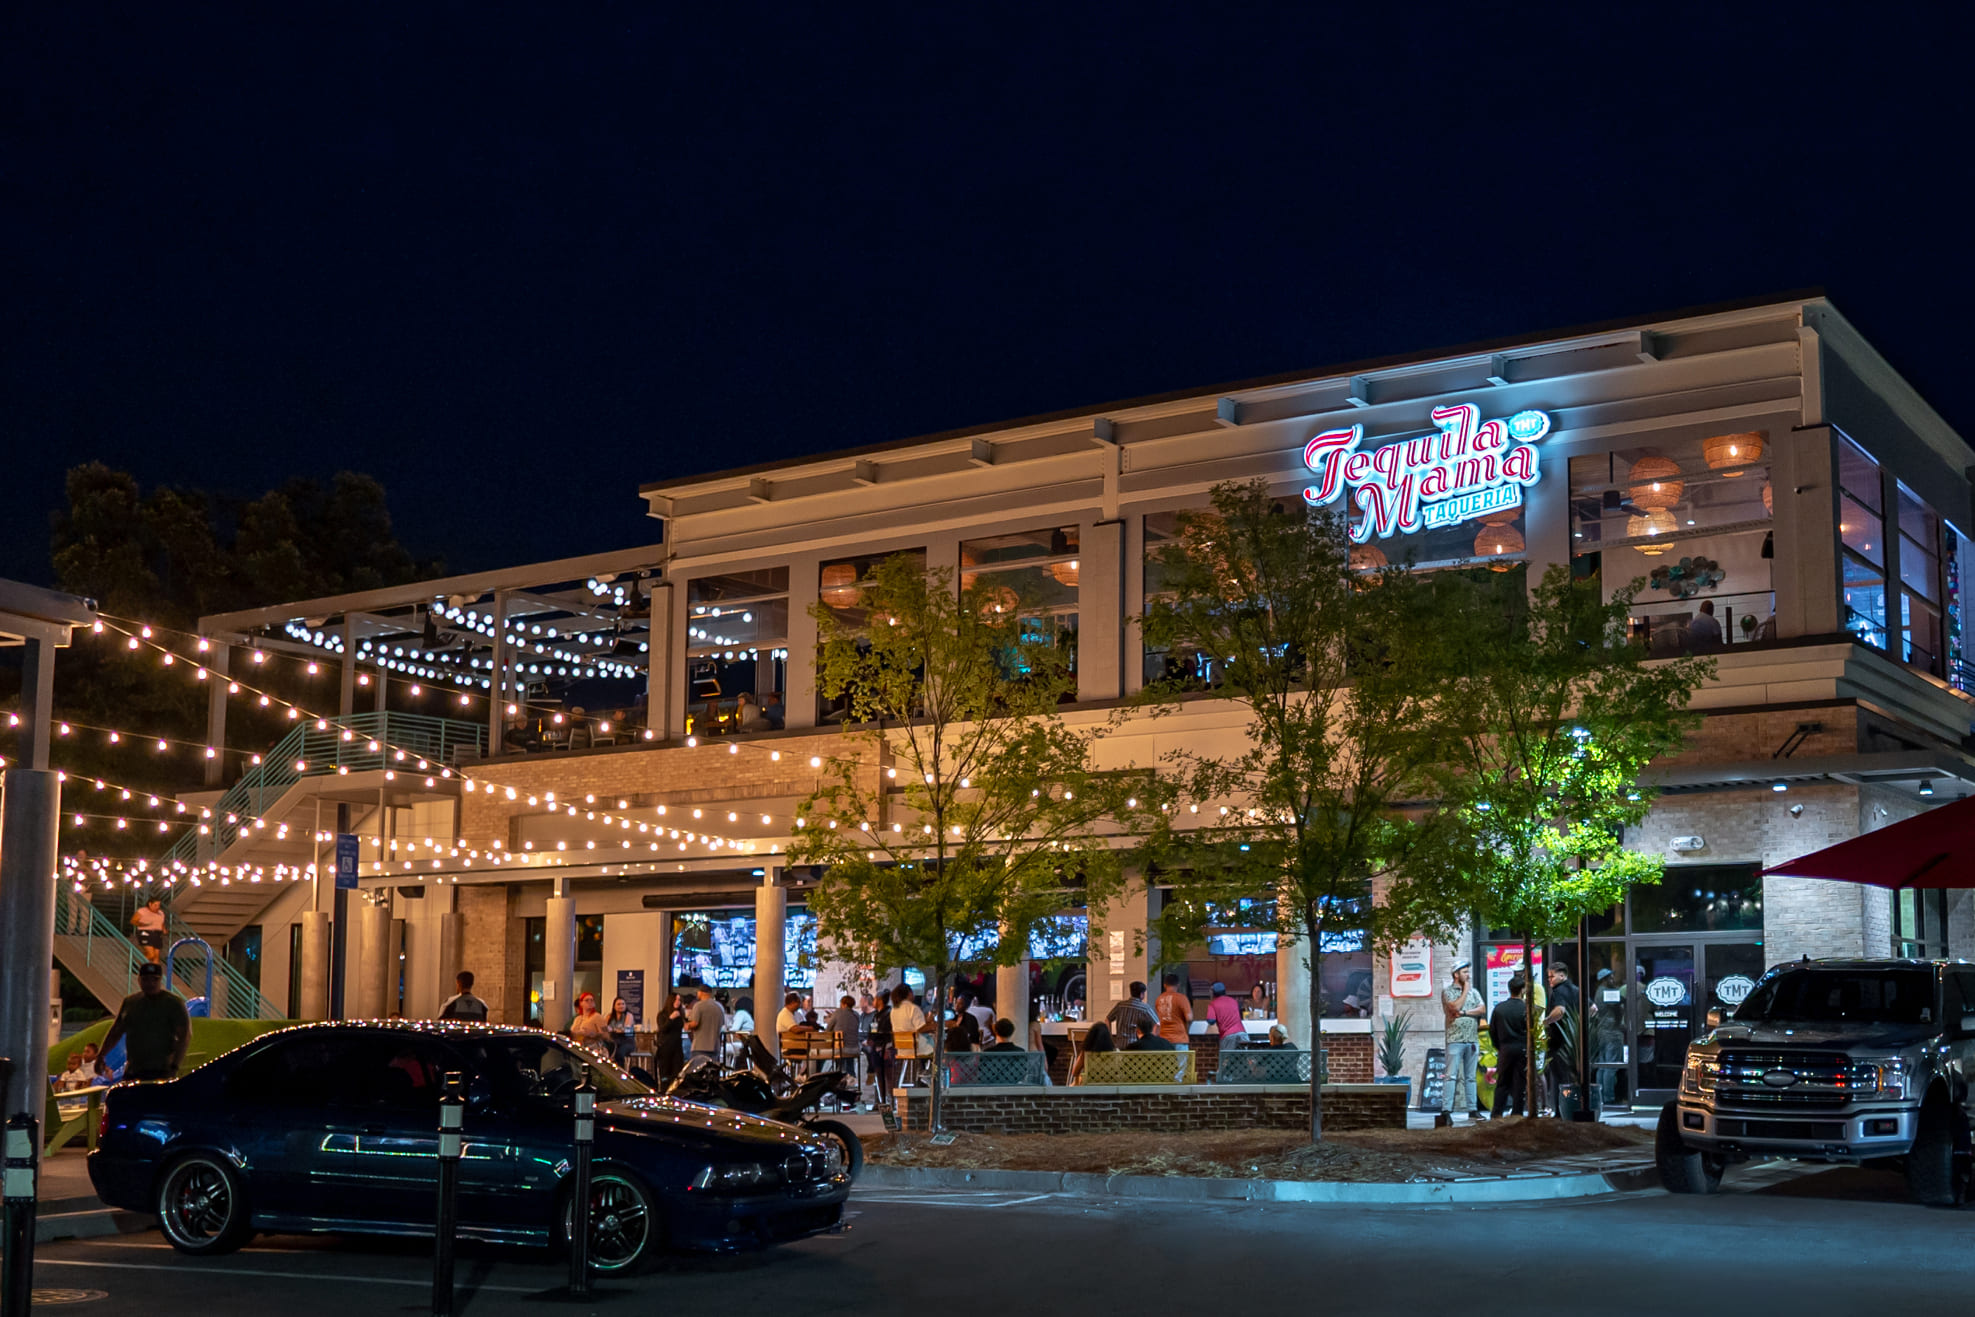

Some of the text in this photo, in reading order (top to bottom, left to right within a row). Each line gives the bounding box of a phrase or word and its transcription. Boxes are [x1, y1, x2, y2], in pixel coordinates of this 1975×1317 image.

[1303, 403, 1506, 502] Tequila
[1350, 445, 1536, 539] Mama
[1424, 485, 1515, 523] TAQUERIA
[1653, 985, 1679, 999] TMT
[1723, 983, 1750, 998] TMT
